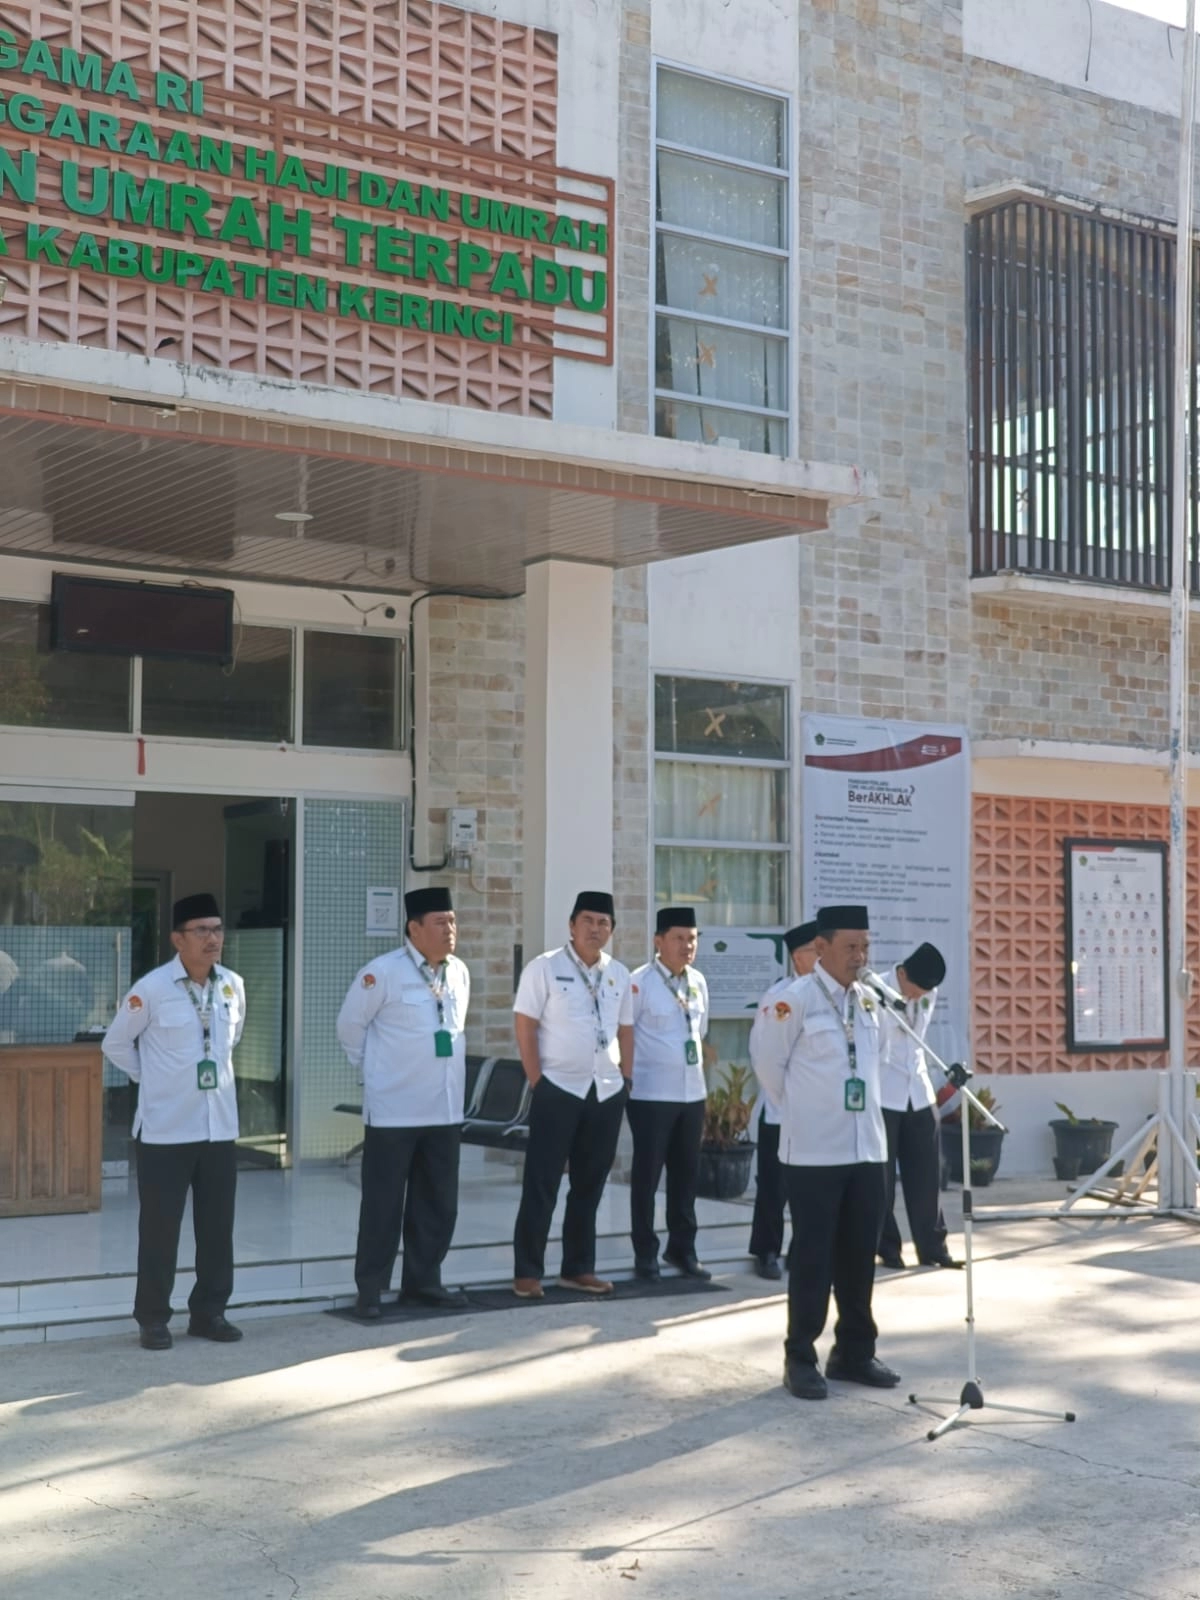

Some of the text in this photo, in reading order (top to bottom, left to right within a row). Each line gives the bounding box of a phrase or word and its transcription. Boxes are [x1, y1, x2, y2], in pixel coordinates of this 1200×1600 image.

[155, 71, 204, 116] RI
[0, 94, 608, 255] GARAAN HAJI DAN UMRAH
[25, 223, 514, 345] KABUPATEN KERINCI
[61, 160, 312, 257] UMRAH
[333, 216, 607, 313] TERPADU
[848, 790, 912, 807] BerAKHLAK
